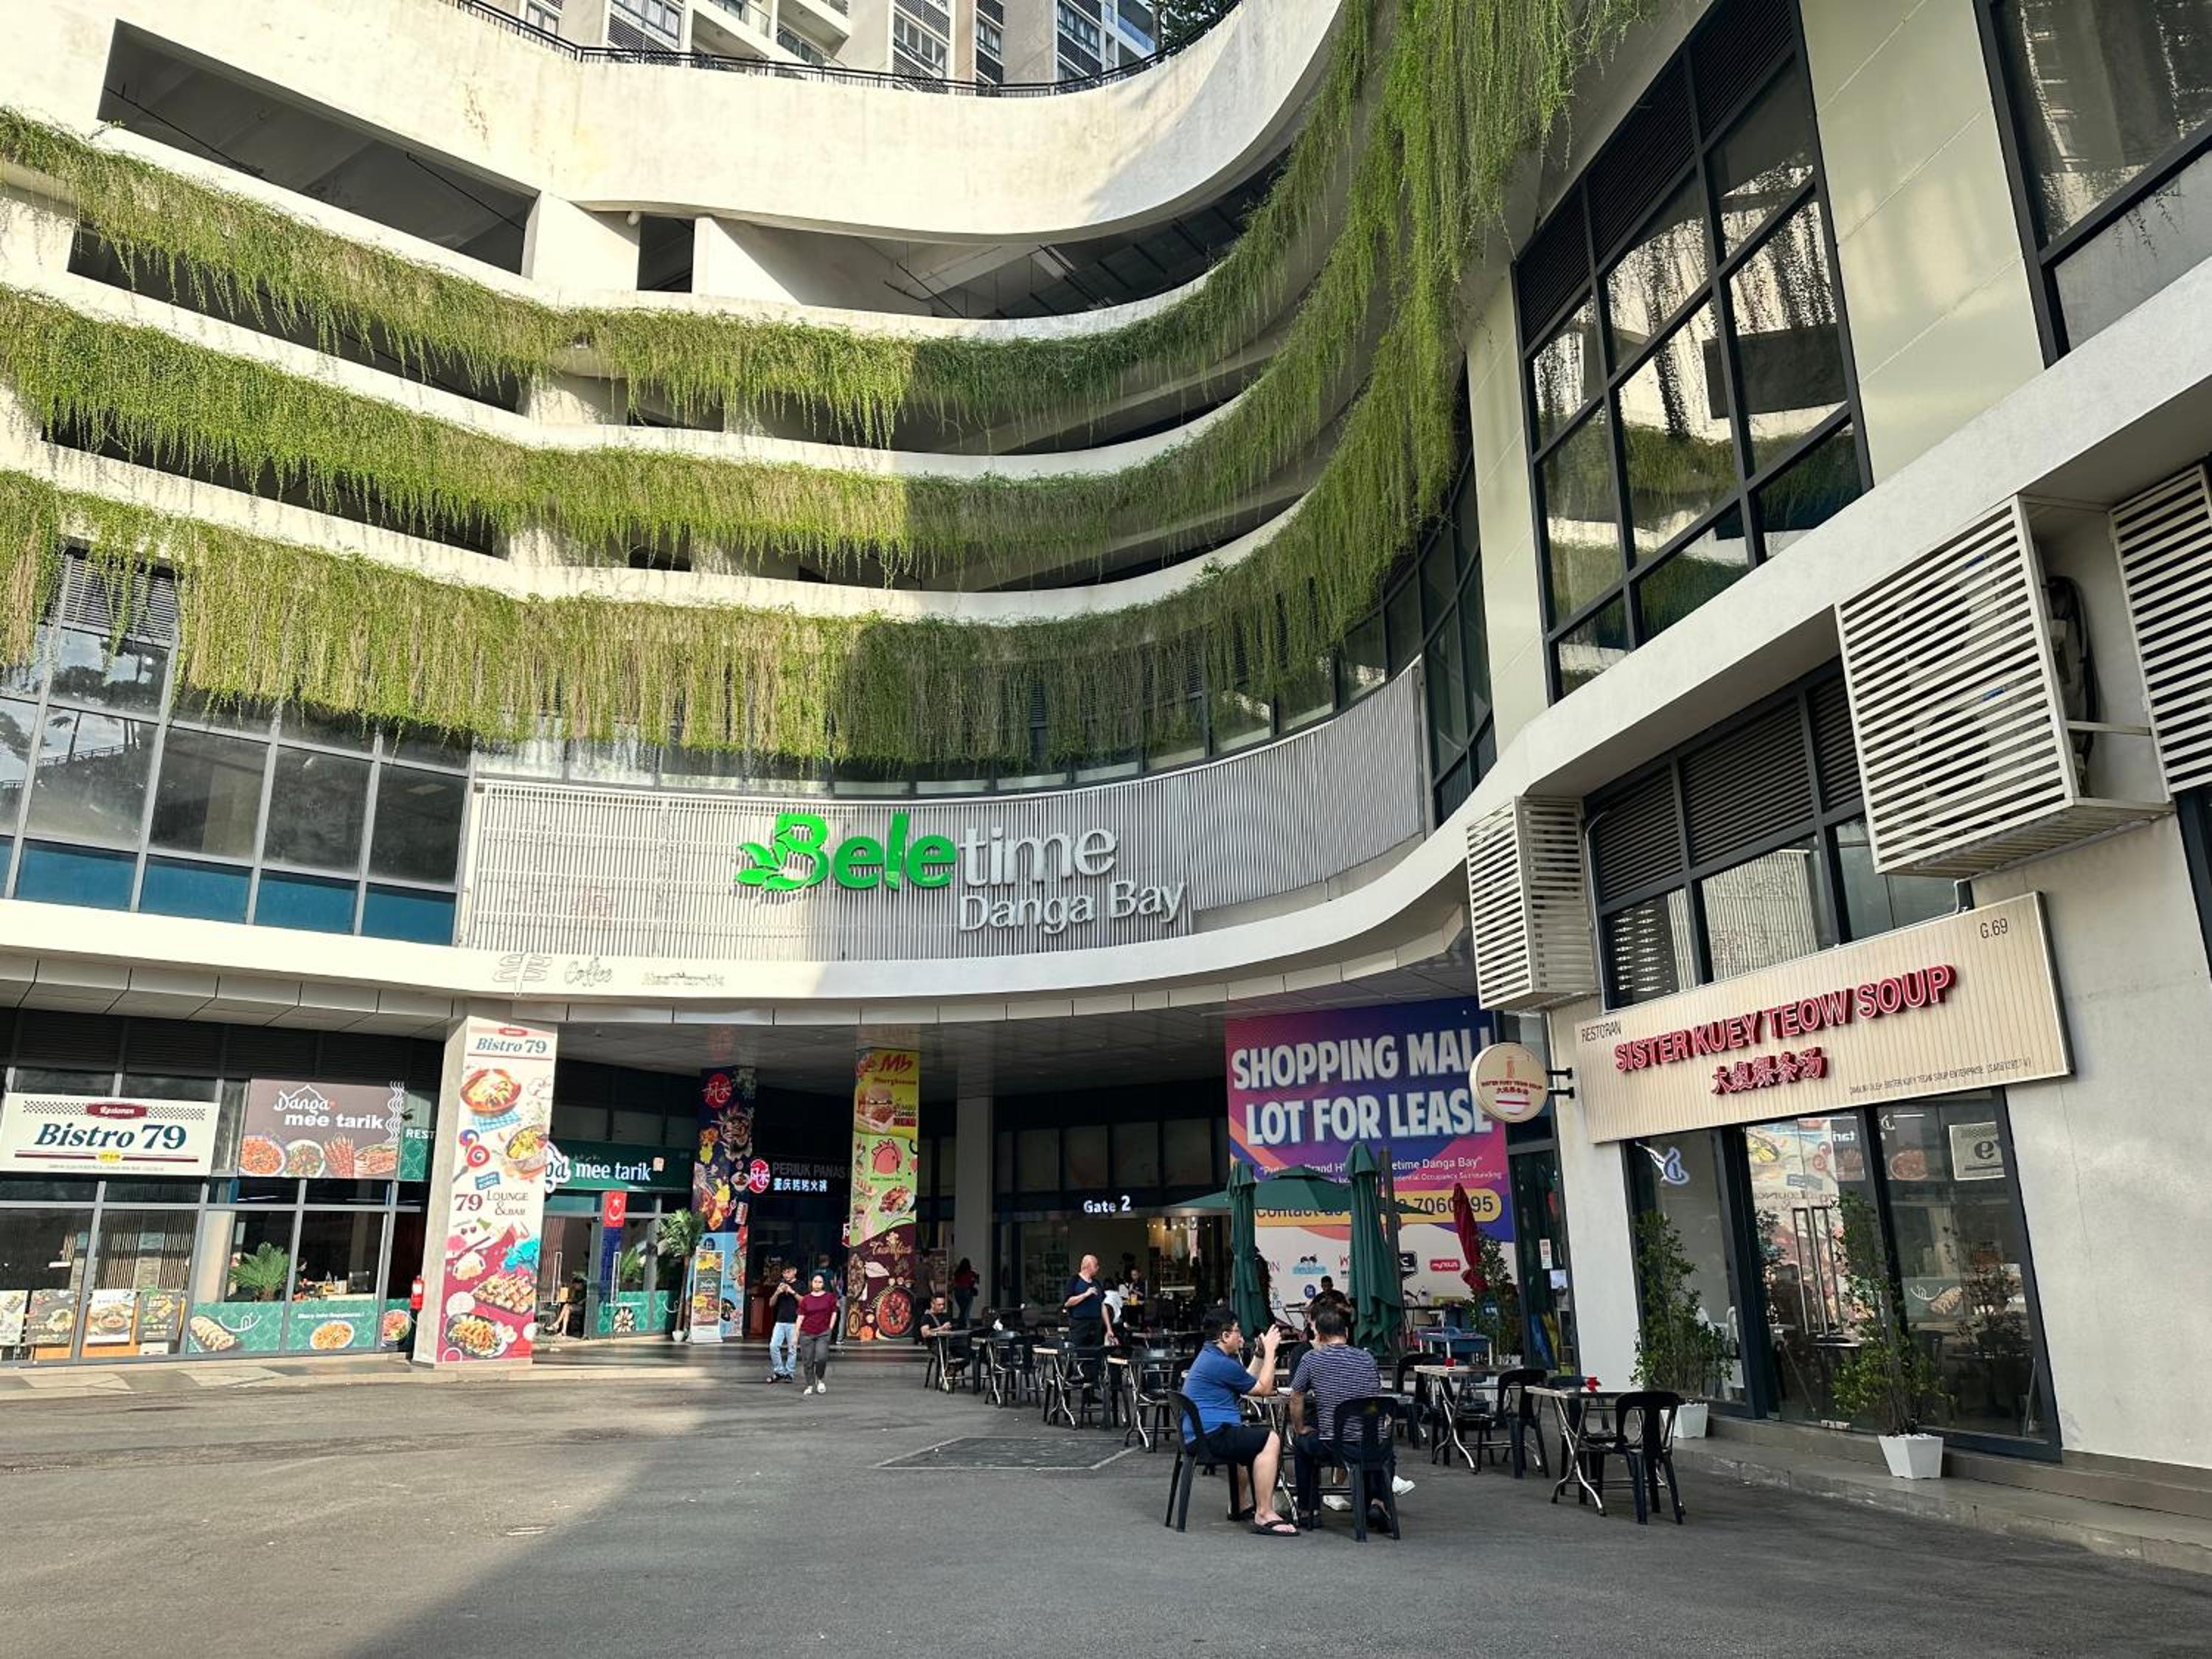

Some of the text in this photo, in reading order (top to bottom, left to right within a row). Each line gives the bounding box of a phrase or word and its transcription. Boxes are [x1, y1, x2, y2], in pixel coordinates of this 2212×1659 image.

[959, 880, 1186, 935] Danga Bay
[1979, 918, 2010, 941] G.69
[1614, 964, 1958, 1074] SISTER KUEY TEOW SOUP
[1581, 1020, 1622, 1043] RESTORAN
[476, 1037, 547, 1054] Bistro 79
[1231, 1035, 1399, 1091] SHOPPING
[273, 1089, 331, 1116] Danga
[284, 1113, 386, 1130] mee tarik
[1246, 1086, 1493, 1147] LOT FOR LEASE
[33, 1121, 187, 1150] Bistro 79
[575, 1162, 611, 1180] mee
[615, 1161, 652, 1181] tarik
[772, 1161, 811, 1178] PERIUK
[813, 1164, 846, 1180] PANAS
[1422, 1158, 1456, 1170] Danga
[454, 1193, 484, 1211] 79
[1083, 1194, 1132, 1214] Gate 2
